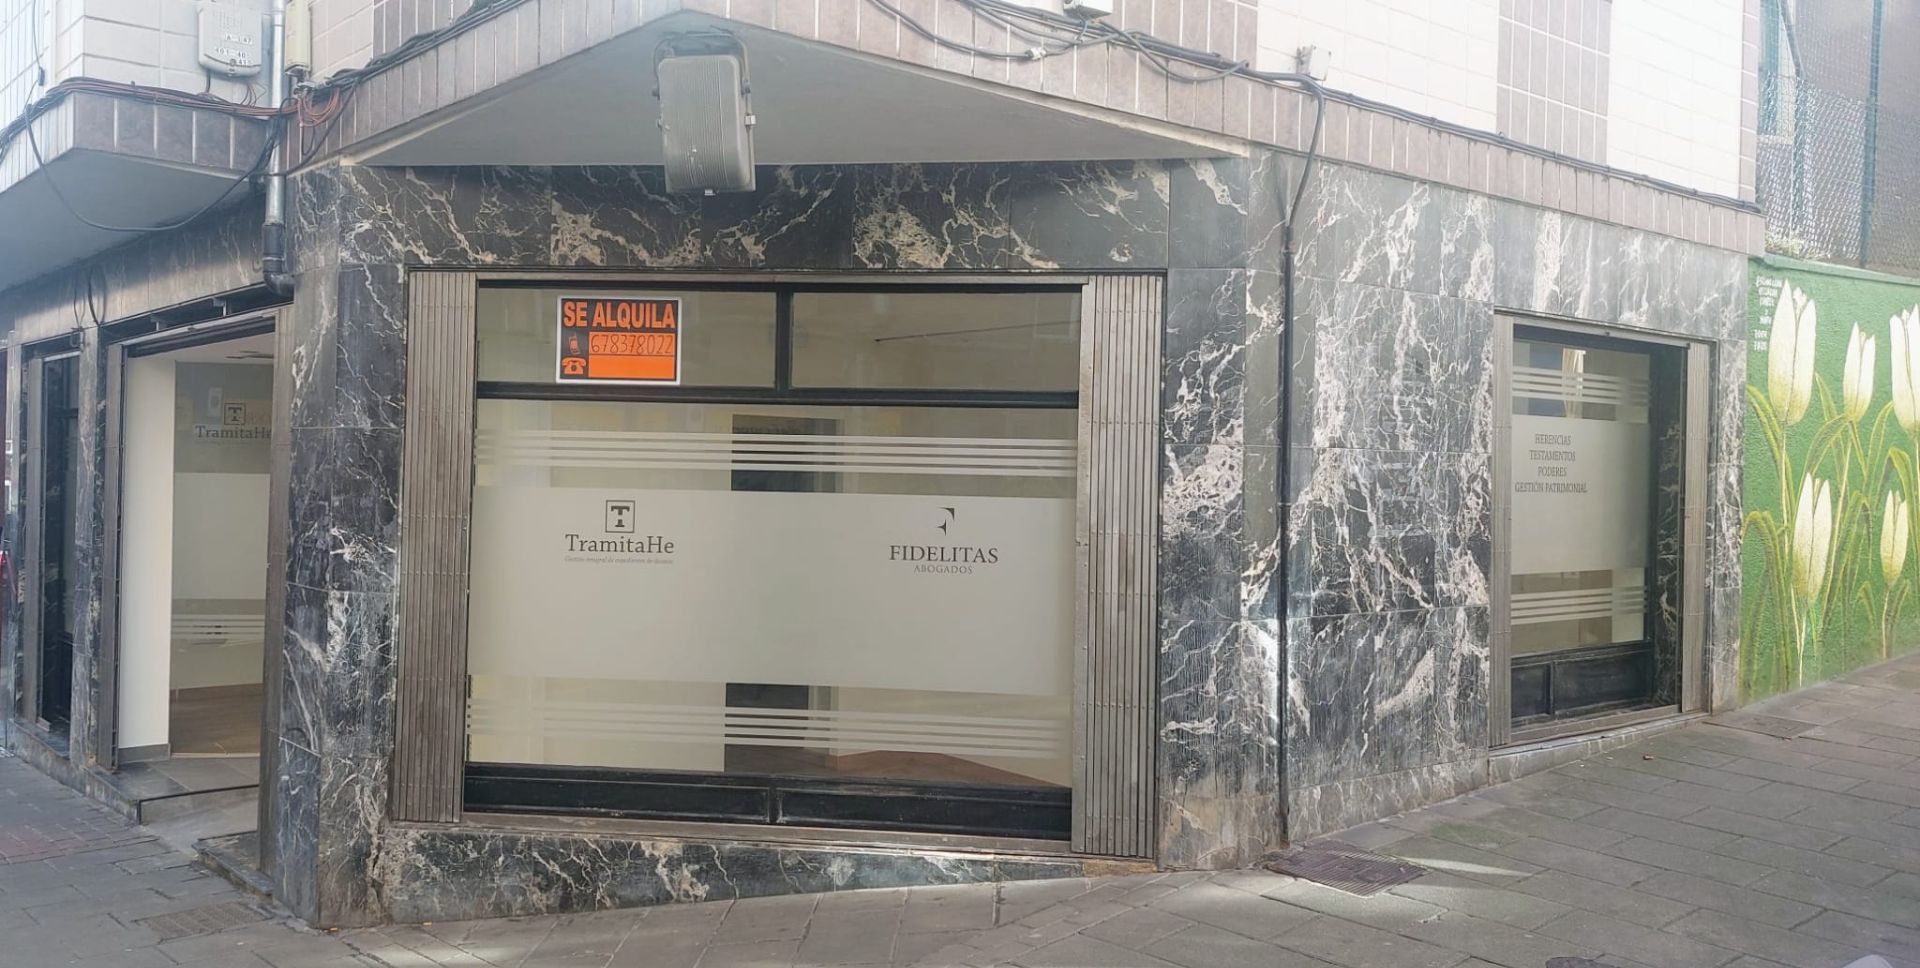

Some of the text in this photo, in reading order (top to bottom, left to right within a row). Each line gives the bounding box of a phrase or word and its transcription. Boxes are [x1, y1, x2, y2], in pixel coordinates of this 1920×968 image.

[563, 301, 676, 330] SE ALQUILA
[591, 334, 673, 355] 678378022
[1534, 434, 1572, 446] HERENCIAS
[1529, 449, 1576, 462] TESTAMENTOS
[1537, 466, 1568, 477] PODERES
[1545, 482, 1588, 494] PATRIMONIAL
[610, 505, 630, 528] T
[565, 533, 675, 554] TramitaHe
[889, 545, 999, 564] FIDELITAS
[914, 565, 973, 575] ABOGADOS
